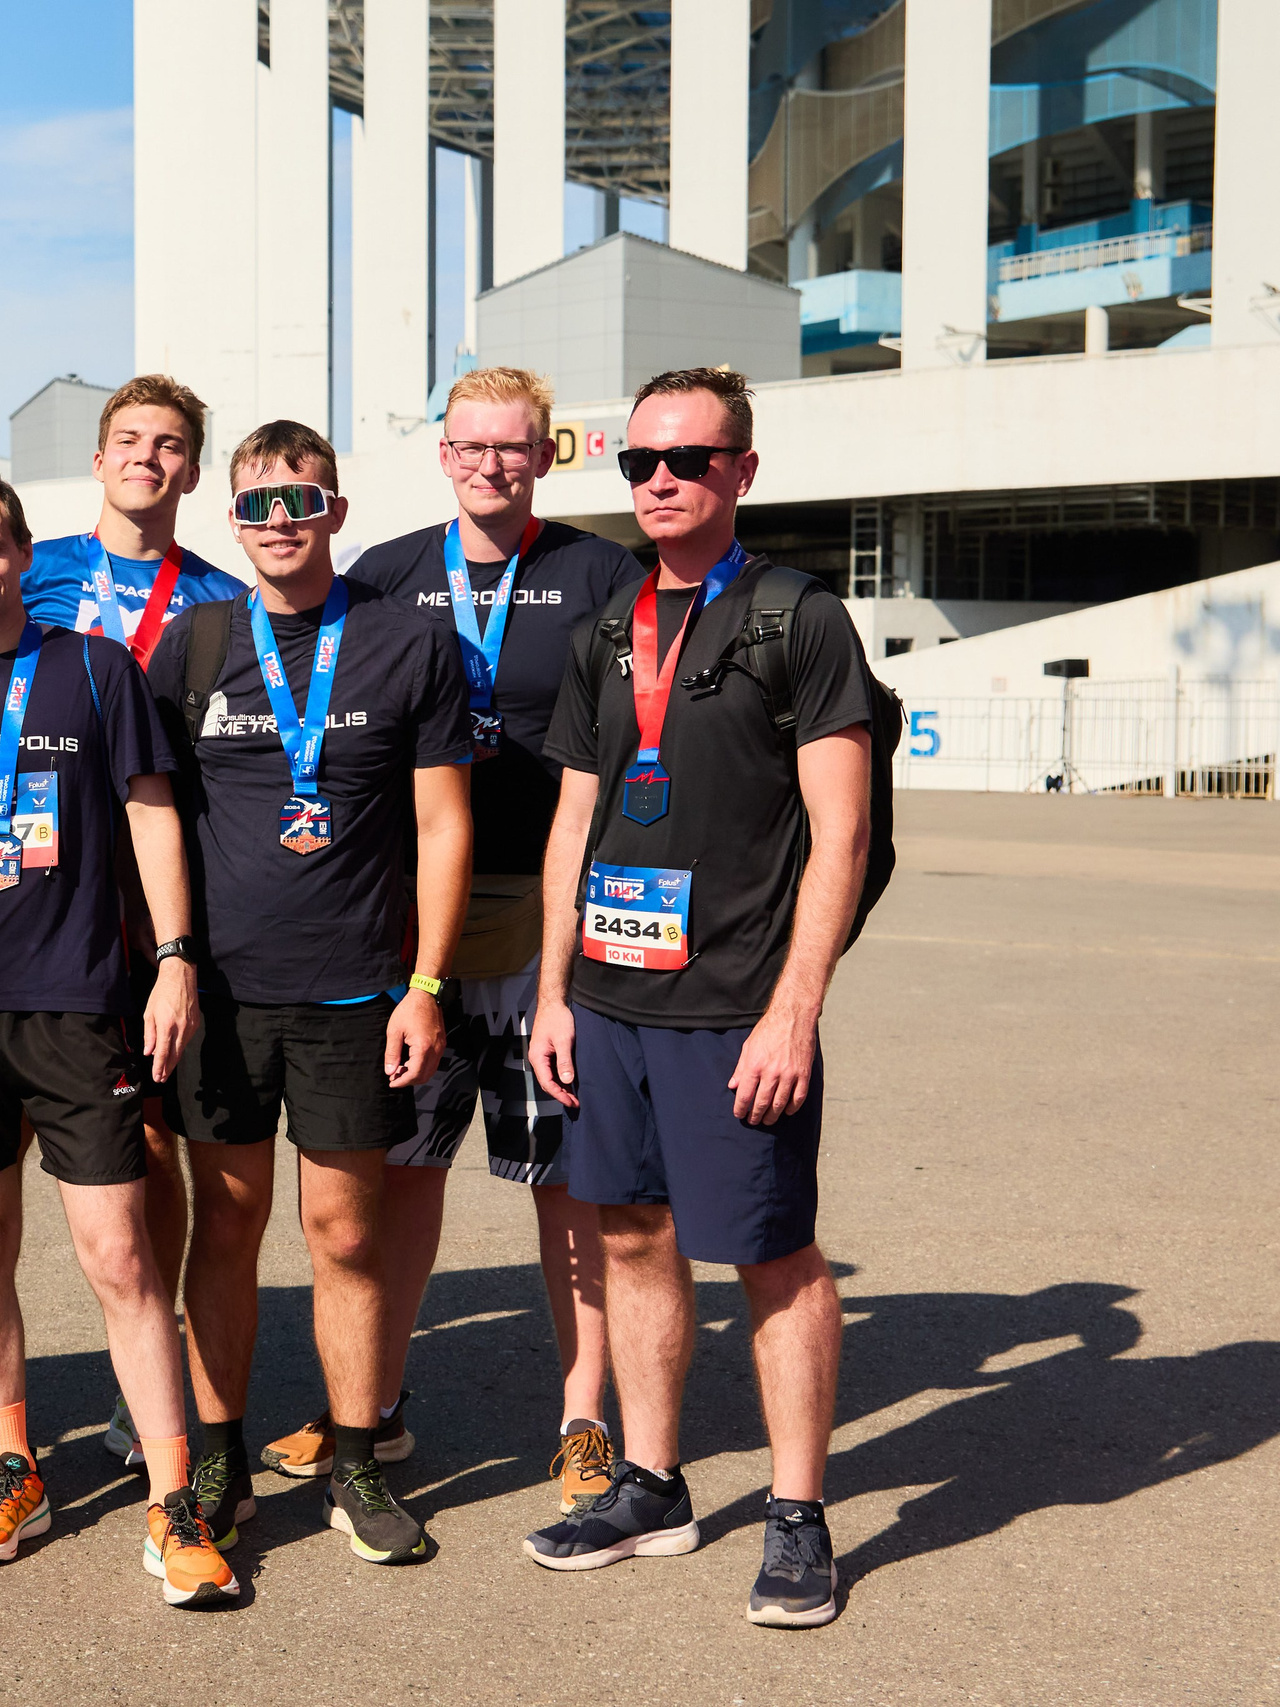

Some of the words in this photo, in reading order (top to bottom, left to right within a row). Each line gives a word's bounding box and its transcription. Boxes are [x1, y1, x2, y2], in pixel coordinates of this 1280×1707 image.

[556, 429, 576, 465] D
[589, 431, 603, 456] C
[909, 711, 941, 757] 5
[39, 826, 49, 839] B
[594, 914, 662, 940] 2434
[667, 926, 679, 940] B
[607, 949, 620, 960] 10
[622, 951, 642, 963] KM
